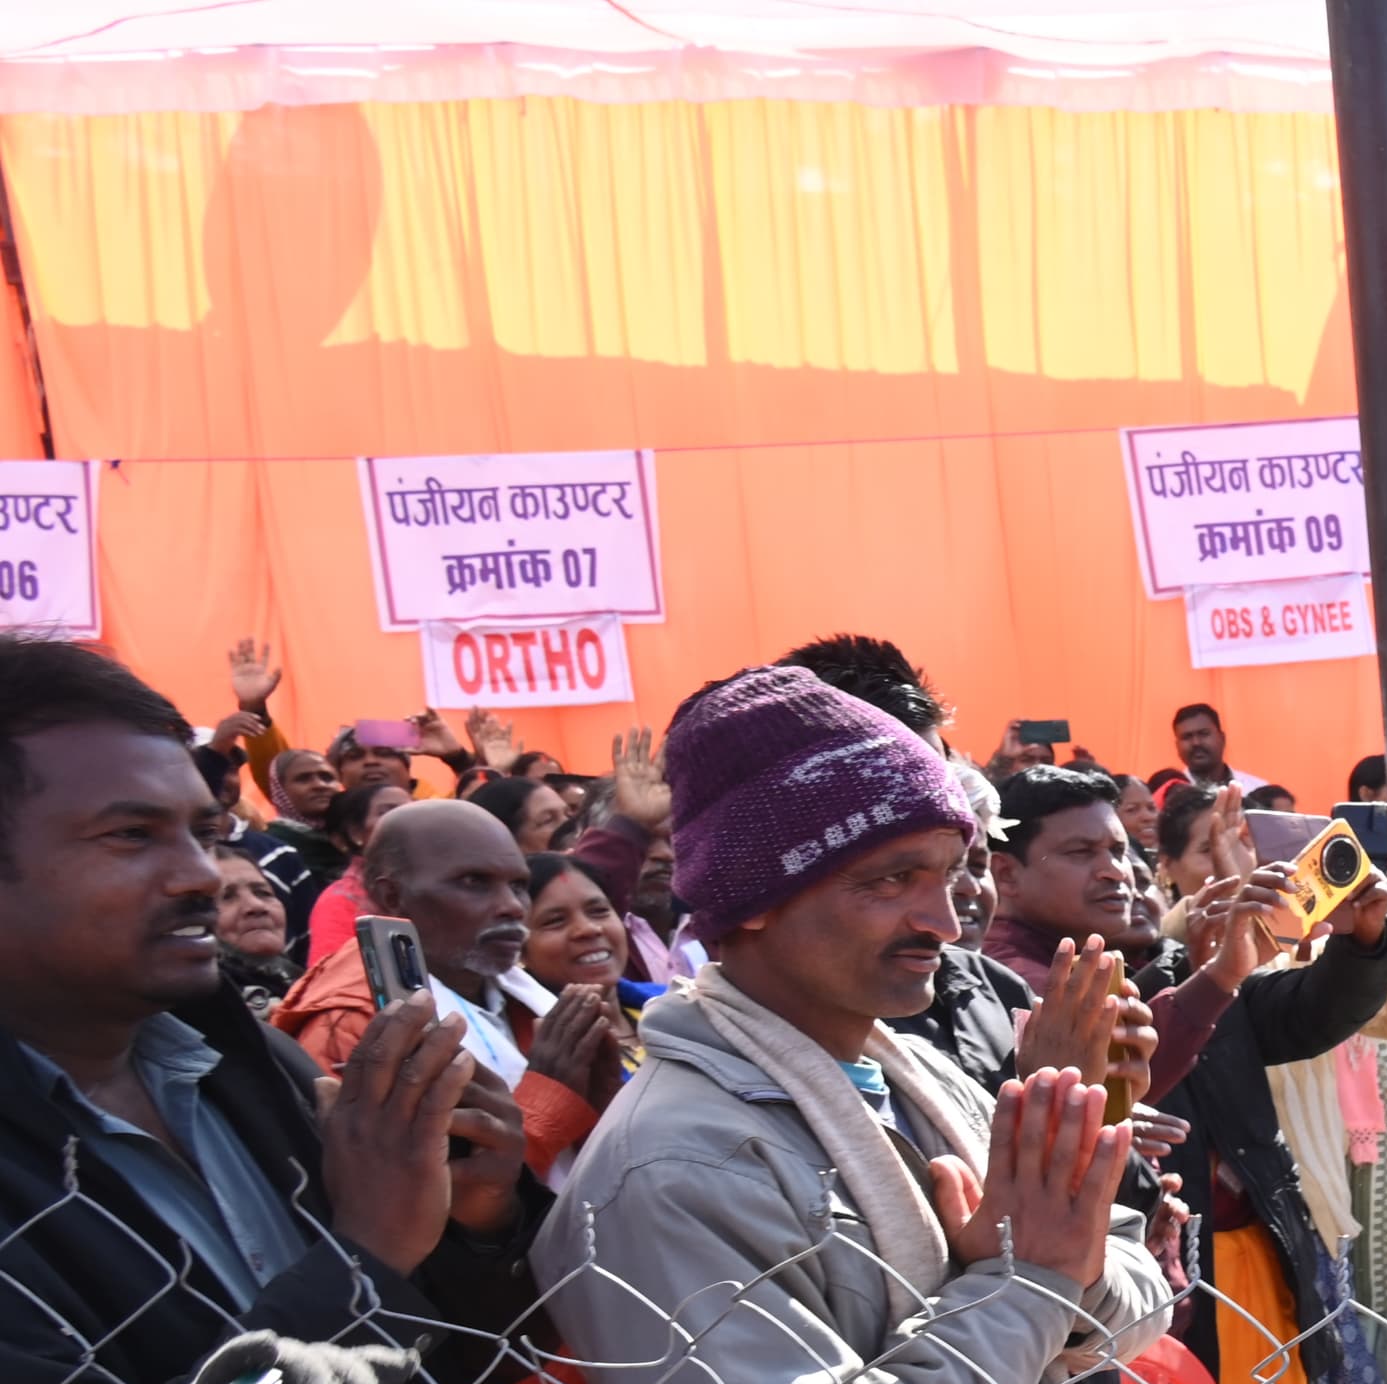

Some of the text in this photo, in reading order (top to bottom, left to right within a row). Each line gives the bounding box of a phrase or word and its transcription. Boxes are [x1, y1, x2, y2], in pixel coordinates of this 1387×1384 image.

[1146, 451, 1250, 498] पंजीयन
[386, 477, 633, 526] पंजीयन काउण्टर
[1194, 509, 1343, 562] क्रमांक 09
[0, 560, 38, 601] 06
[442, 539, 597, 595] क्रमांक 07
[1211, 601, 1353, 640] OBS & GYNEE
[453, 628, 606, 695] ORTHO
